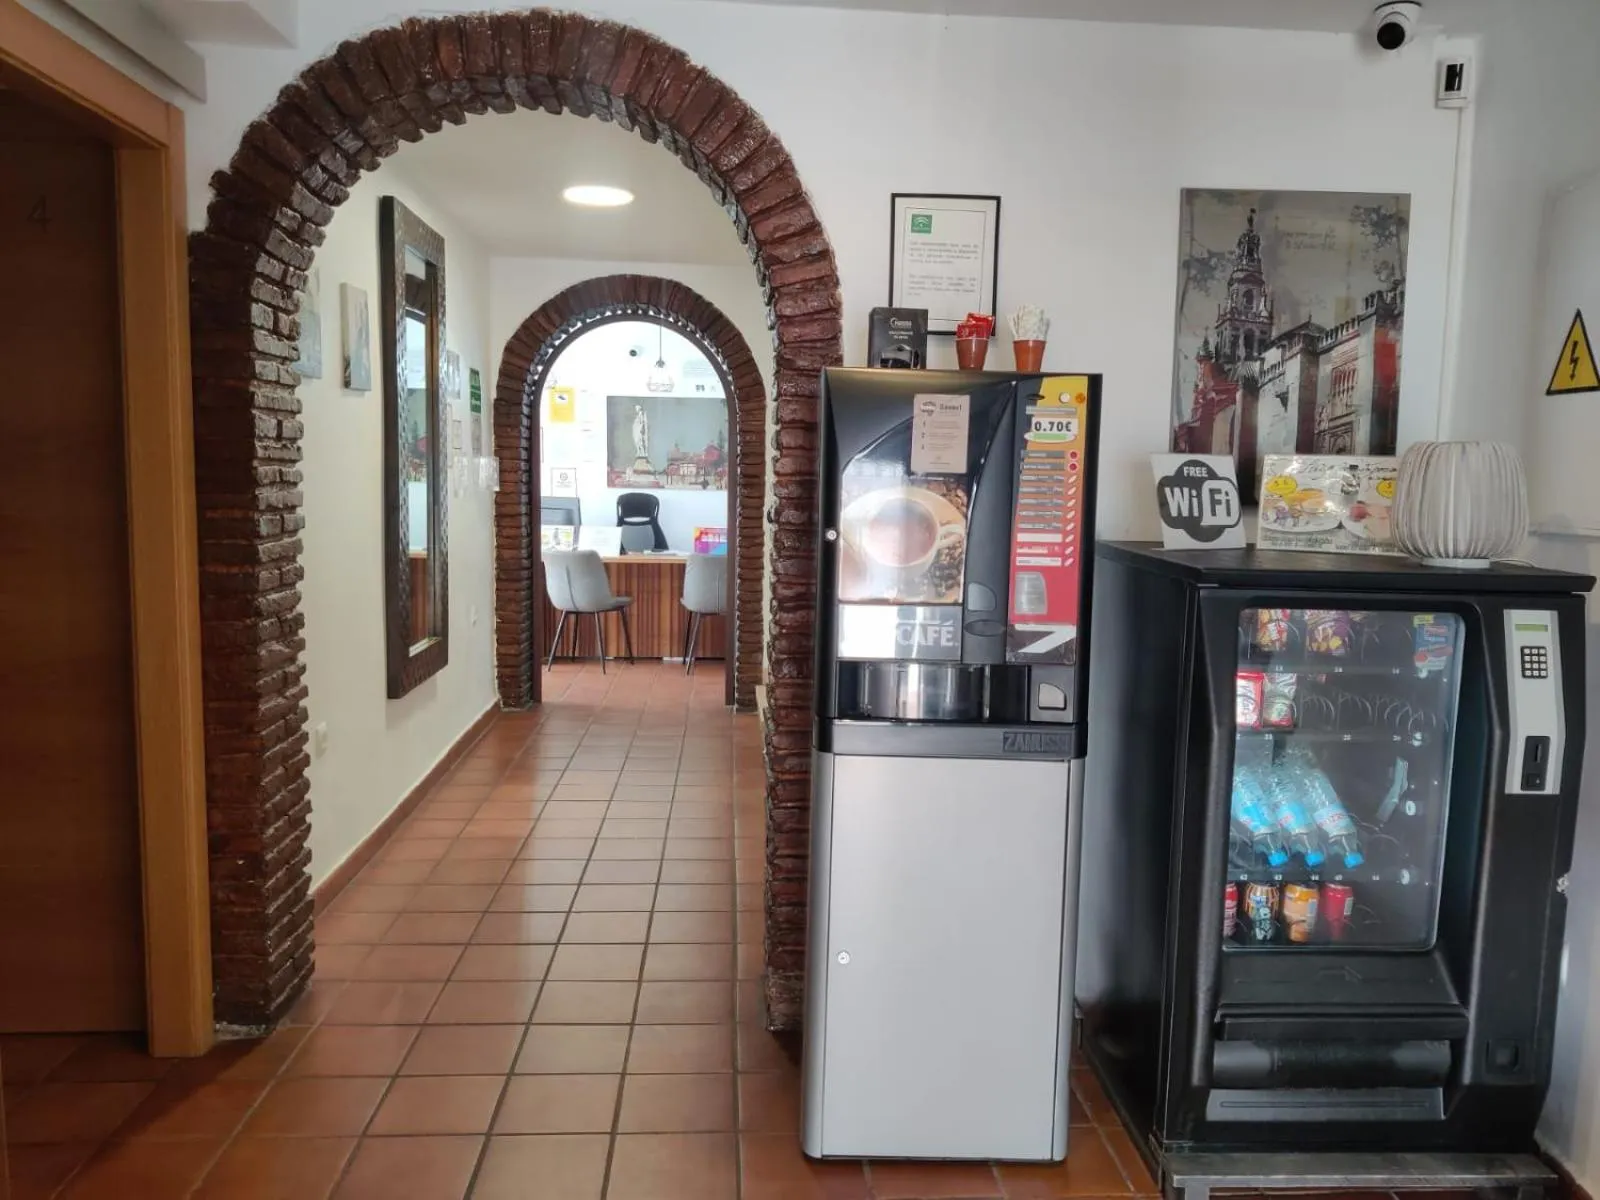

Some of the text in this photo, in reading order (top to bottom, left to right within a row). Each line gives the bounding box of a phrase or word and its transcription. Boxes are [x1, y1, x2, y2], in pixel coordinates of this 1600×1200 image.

[27, 195, 53, 227] 4
[1034, 421, 1072, 432] 0.70€
[1183, 466, 1208, 477] FREE
